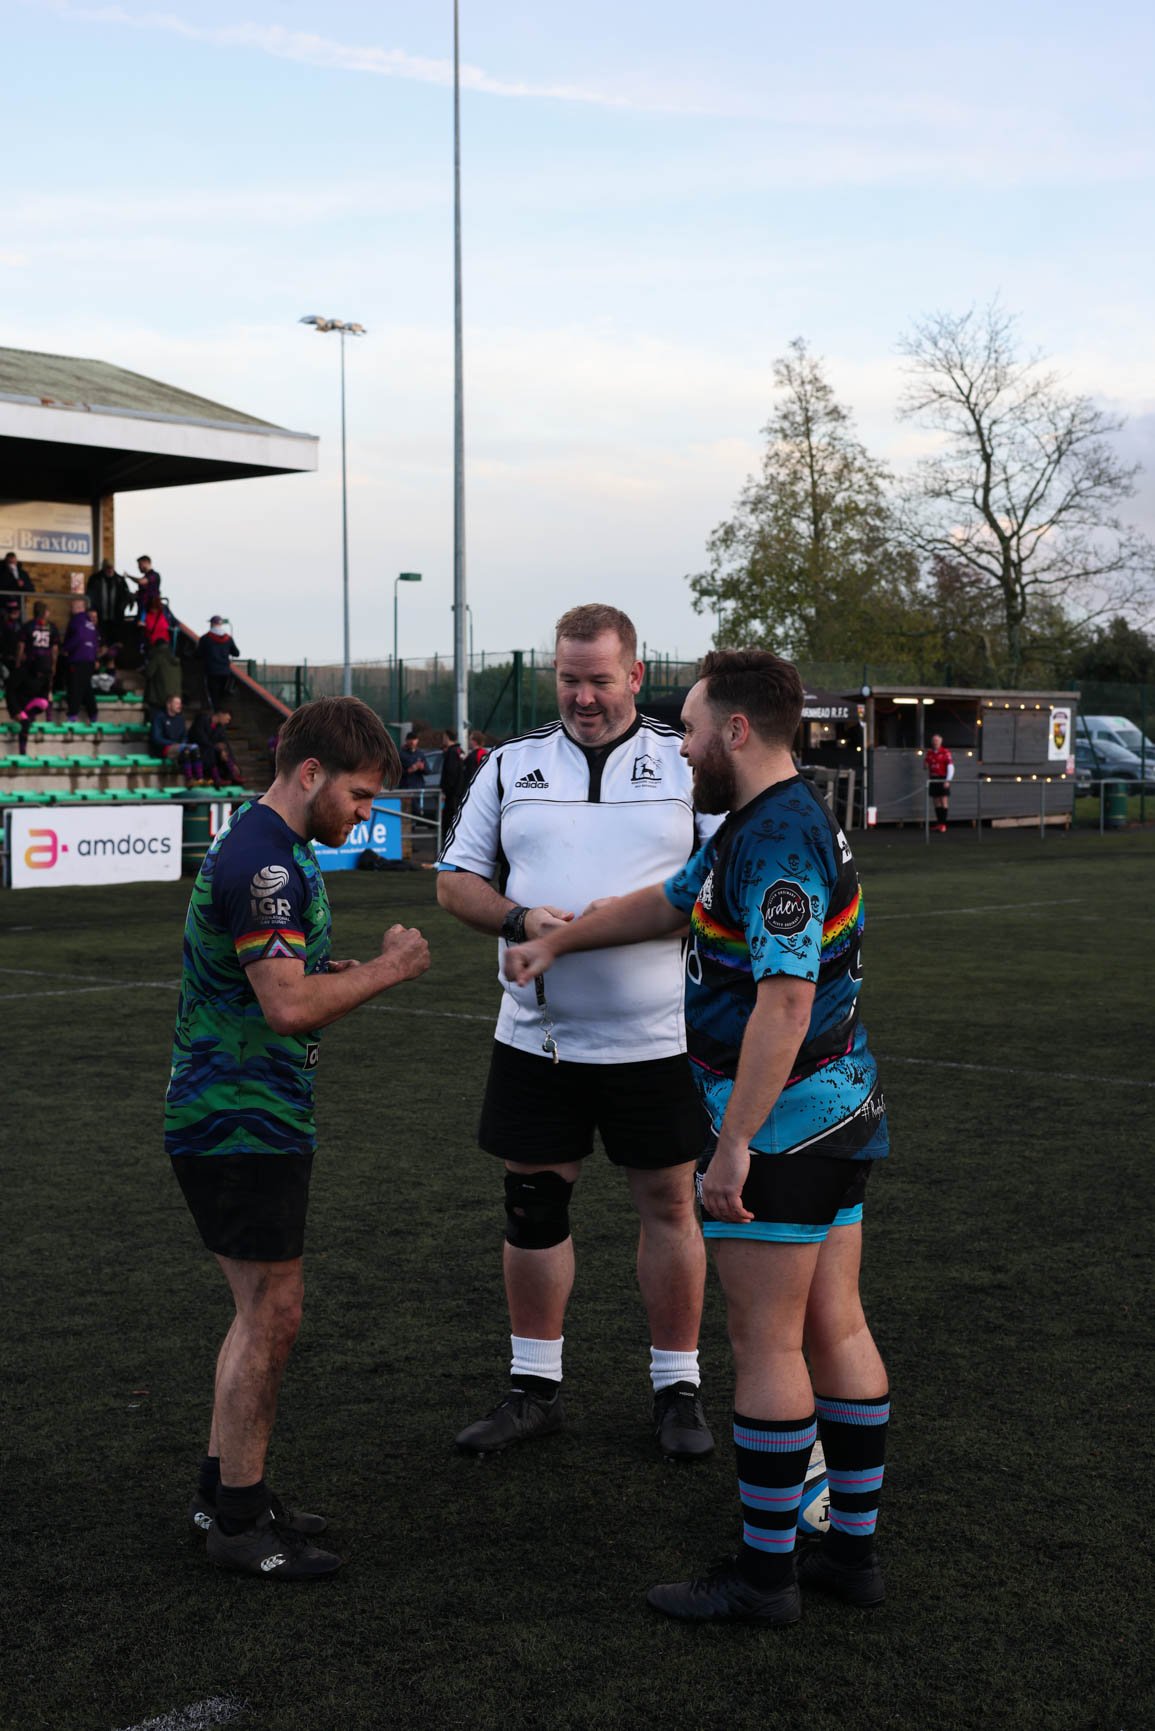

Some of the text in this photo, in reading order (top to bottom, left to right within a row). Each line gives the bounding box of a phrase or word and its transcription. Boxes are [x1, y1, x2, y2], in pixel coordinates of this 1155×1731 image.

[20, 530, 88, 553] Braxton
[32, 630, 50, 648] 25
[515, 780, 549, 789] adidas
[77, 835, 171, 856] amdocs
[250, 898, 291, 916] IGR
[765, 896, 806, 920] ardens
